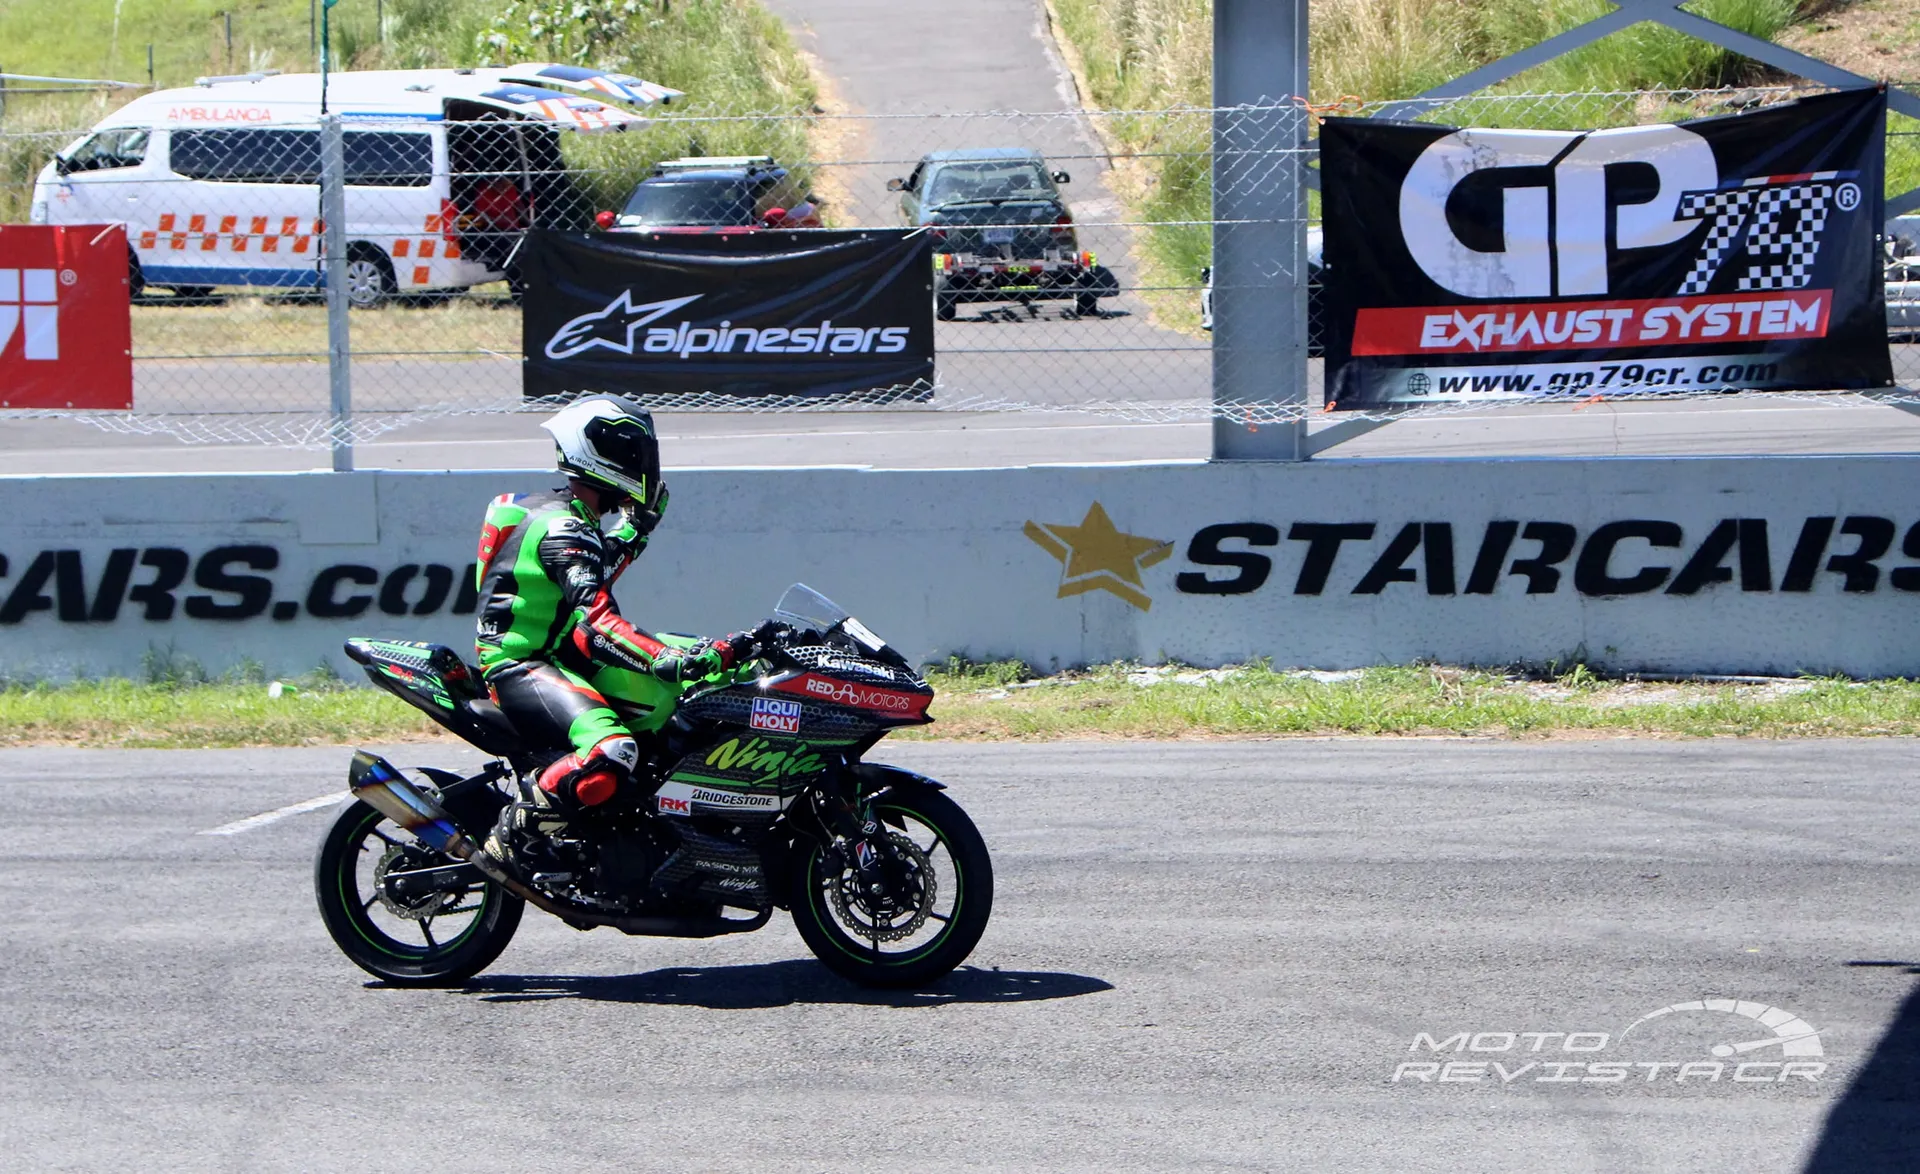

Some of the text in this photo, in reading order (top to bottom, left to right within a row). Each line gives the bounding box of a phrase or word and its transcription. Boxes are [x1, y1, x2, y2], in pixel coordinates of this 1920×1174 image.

[168, 107, 271, 121] AMBULANCIA
[1419, 297, 1823, 351] EXHAUST SYSTEM
[643, 320, 910, 358] alpinestars
[1438, 360, 1777, 394] www.gp79cr.com
[569, 455, 593, 468] AIROH
[0, 545, 477, 623] ARS.co
[605, 641, 647, 671] Kawasaki
[817, 654, 895, 680] Kawasaki
[806, 679, 910, 709] RED MOTORS
[755, 699, 799, 716] LIQUI
[753, 713, 797, 730] MOLY
[705, 737, 827, 784] Ninja
[660, 797, 689, 812] RK
[691, 788, 773, 806] BRIDGESTONE
[695, 860, 739, 873] PASION
[719, 878, 759, 891] Ninja
